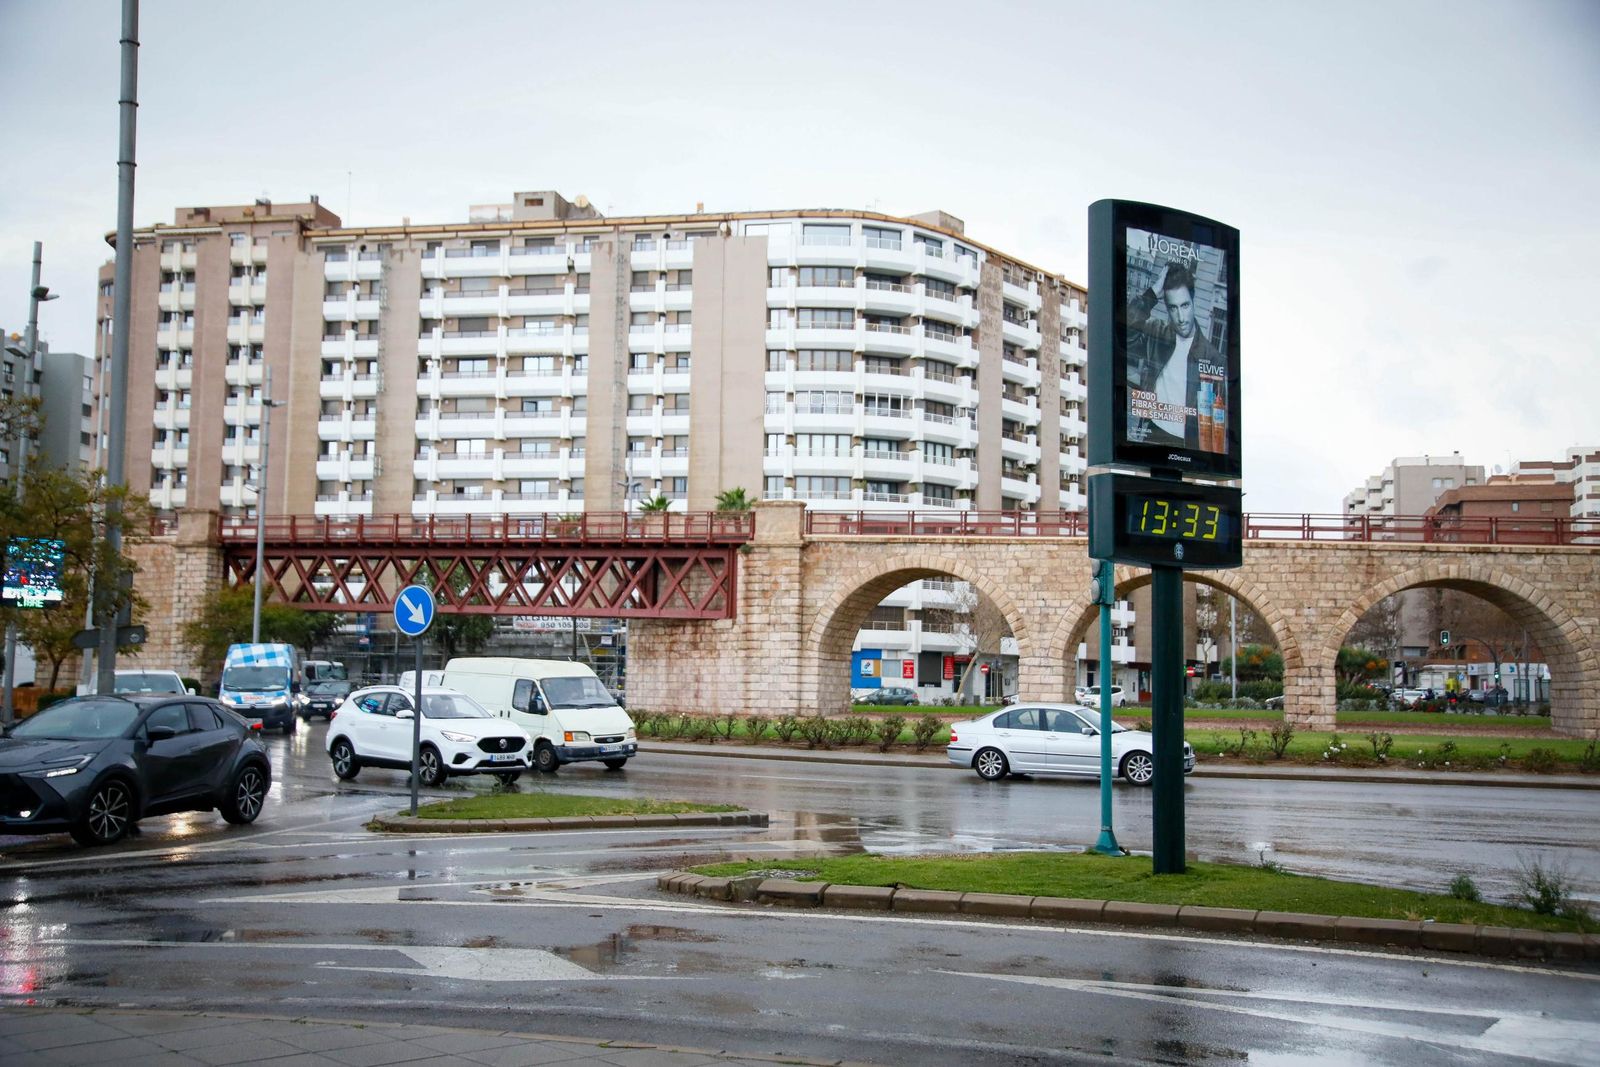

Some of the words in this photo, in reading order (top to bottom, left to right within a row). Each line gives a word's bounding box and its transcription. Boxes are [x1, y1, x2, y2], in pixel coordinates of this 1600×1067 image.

[1167, 256, 1188, 266] PARIS
[1198, 363, 1225, 377] ELVIVE
[1131, 399, 1157, 410] FIBRAS
[1158, 403, 1197, 417] CAPILARES
[1131, 408, 1141, 417] EN
[1142, 409, 1148, 418] 6
[1149, 410, 1183, 423] SEMANAS
[1168, 453, 1191, 462] JCDecaux
[1141, 500, 1220, 539] 13:33
